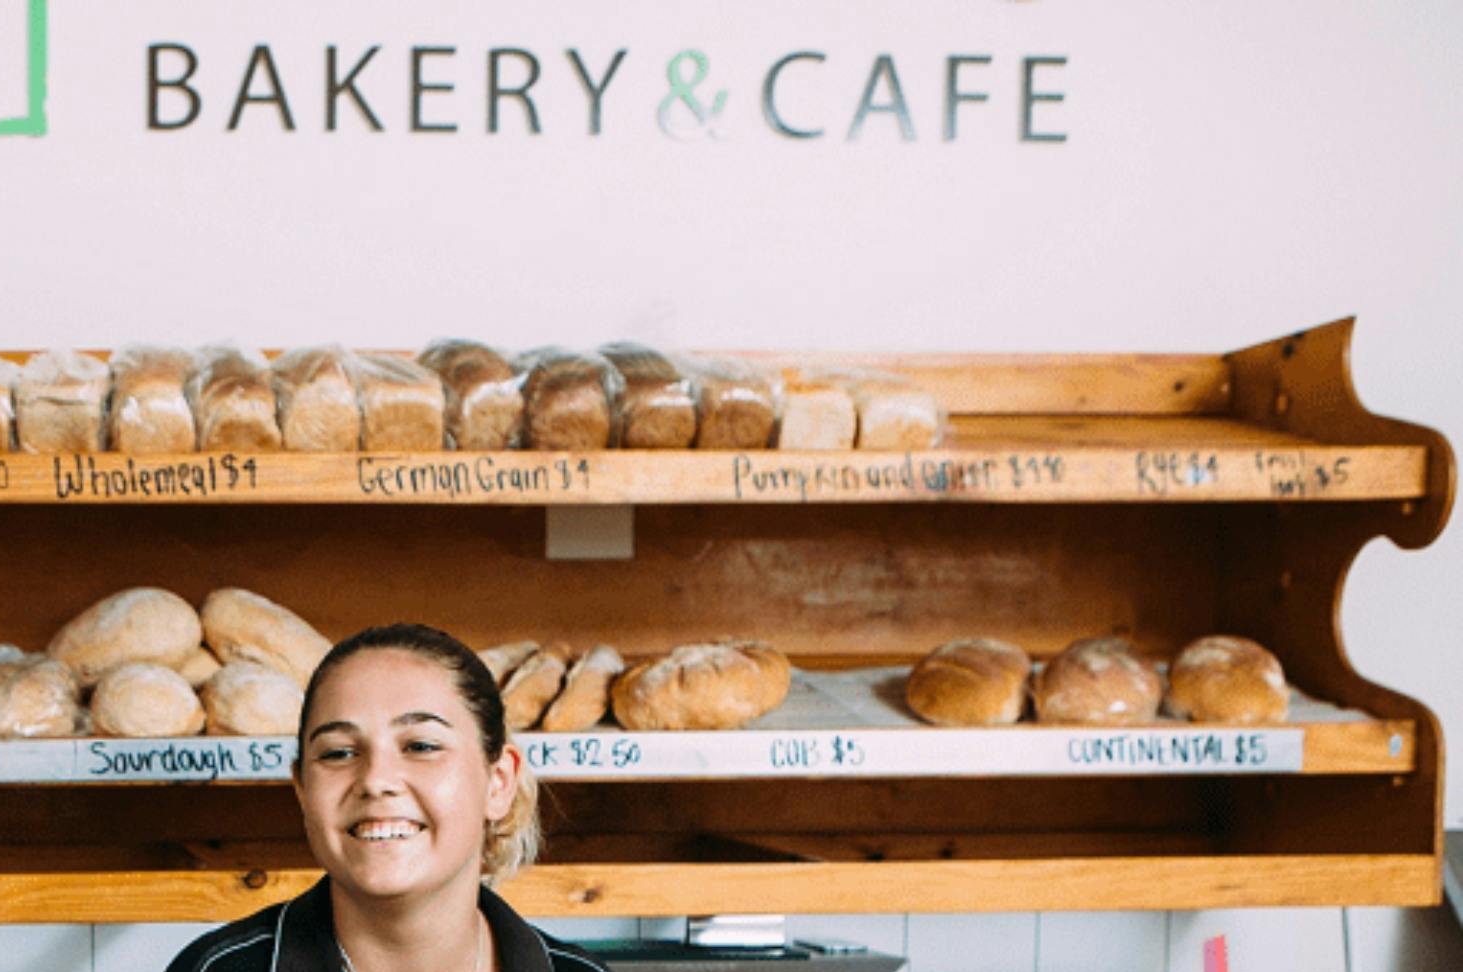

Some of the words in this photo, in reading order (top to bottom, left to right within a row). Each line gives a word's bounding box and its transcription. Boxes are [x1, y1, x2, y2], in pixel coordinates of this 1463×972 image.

[145, 42, 628, 135] BAKERY
[656, 48, 733, 142] &
[760, 50, 1069, 142] CAFE
[53, 453, 217, 499] Wholemeal
[220, 453, 257, 489] $4
[357, 455, 471, 498] German
[475, 456, 550, 492] Grain
[89, 741, 238, 780] Sourdough
[248, 742, 282, 771] $5
[1067, 734, 1224, 765] CONTINENTAL
[1234, 733, 1268, 764] $5
